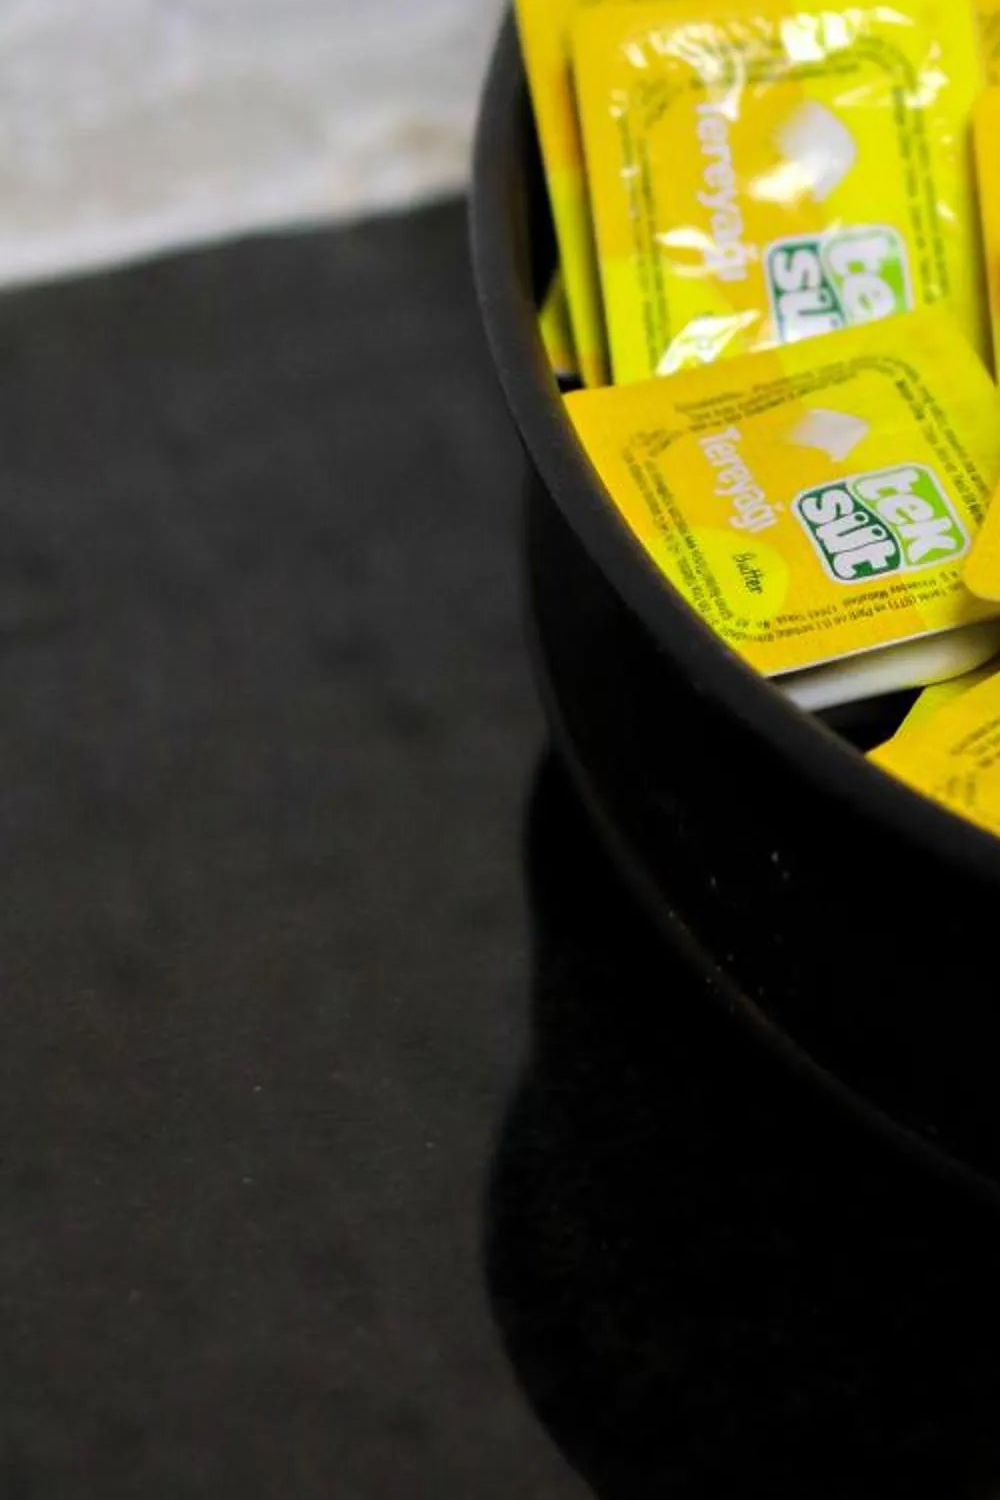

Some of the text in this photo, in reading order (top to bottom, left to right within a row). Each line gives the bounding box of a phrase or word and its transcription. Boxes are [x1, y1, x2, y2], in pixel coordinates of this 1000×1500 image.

[776, 250, 843, 343] sü
[827, 238, 894, 324] te
[698, 426, 785, 534] Tereyağı
[857, 468, 956, 564] tek
[731, 552, 764, 596] Butter
[799, 488, 897, 580] süt
